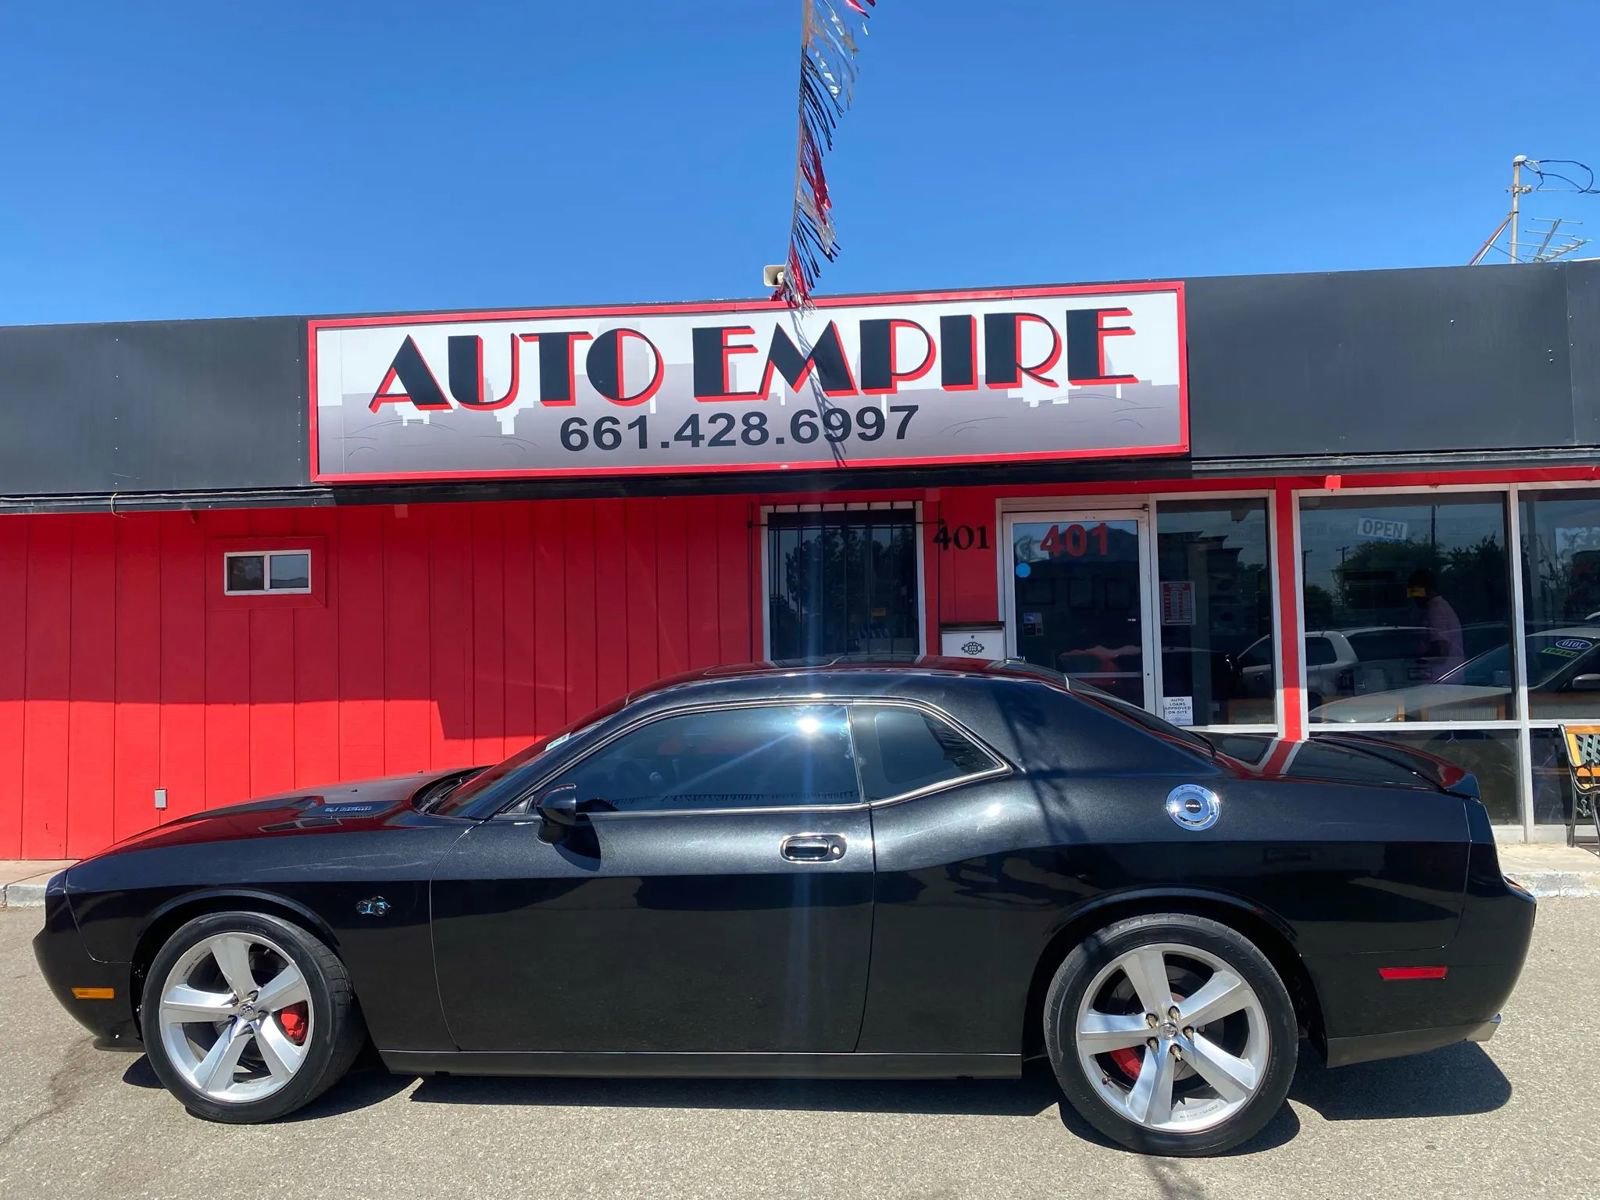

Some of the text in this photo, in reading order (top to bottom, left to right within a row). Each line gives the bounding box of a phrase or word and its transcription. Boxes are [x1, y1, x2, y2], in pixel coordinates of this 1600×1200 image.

[368, 306, 1139, 413] AUTO EMPIRE
[560, 404, 919, 452] 661.428.6997
[932, 524, 991, 551] 401
[1039, 522, 1110, 557] 401
[1362, 519, 1405, 538] OPEN
